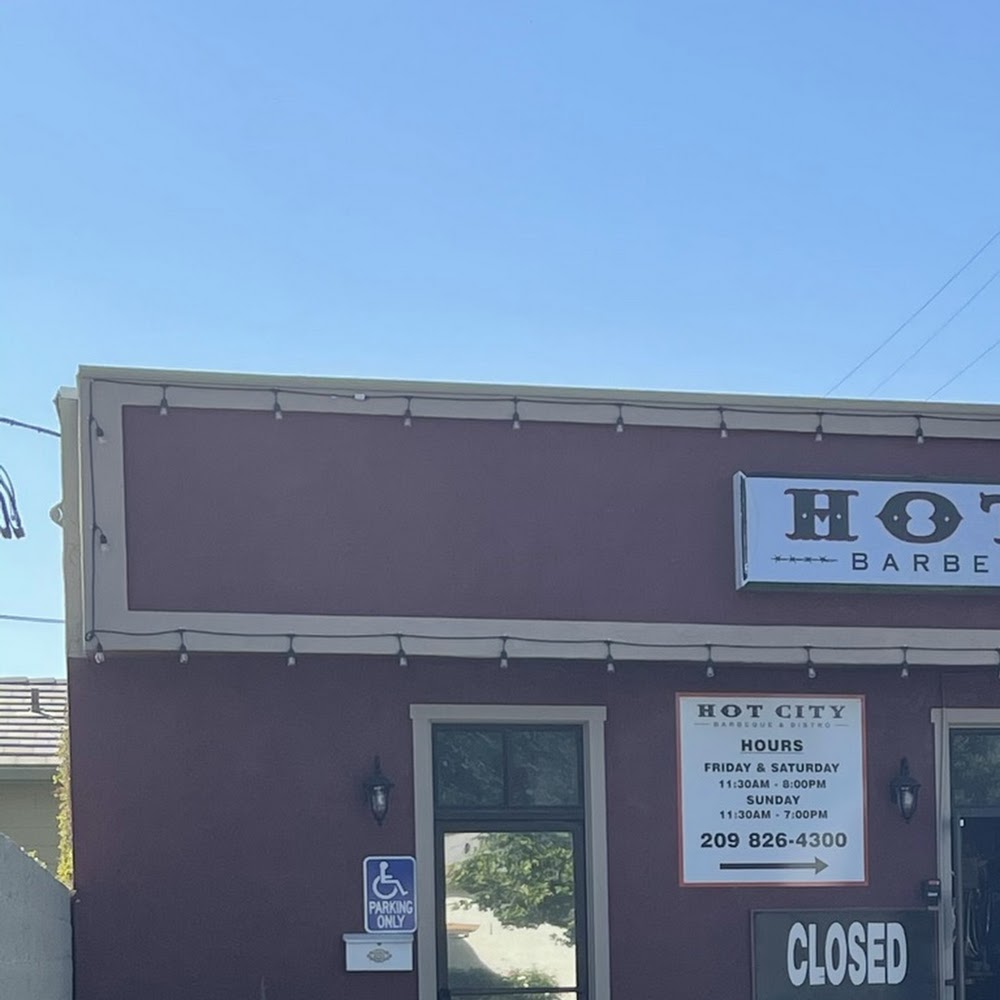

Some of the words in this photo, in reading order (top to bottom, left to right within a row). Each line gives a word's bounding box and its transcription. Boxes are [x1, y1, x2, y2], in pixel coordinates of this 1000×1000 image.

[697, 704, 763, 718] HOT
[775, 705, 845, 719] CITY
[741, 739, 804, 752] HOURS
[704, 763, 751, 773] FRIDAY
[756, 763, 766, 773] &
[771, 763, 840, 773] SATURDAY
[719, 780, 770, 789] 11:30AM
[782, 780, 827, 789] 8:00PM
[746, 795, 801, 805] SUNDAY
[720, 811, 771, 820] 11:30AM
[784, 811, 828, 820] 7:00PM
[700, 833, 740, 848] 209
[748, 833, 848, 848] 826-4300
[369, 901, 413, 914] PARKING
[377, 914, 405, 928] ONLY
[787, 922, 907, 986] CLOSED
